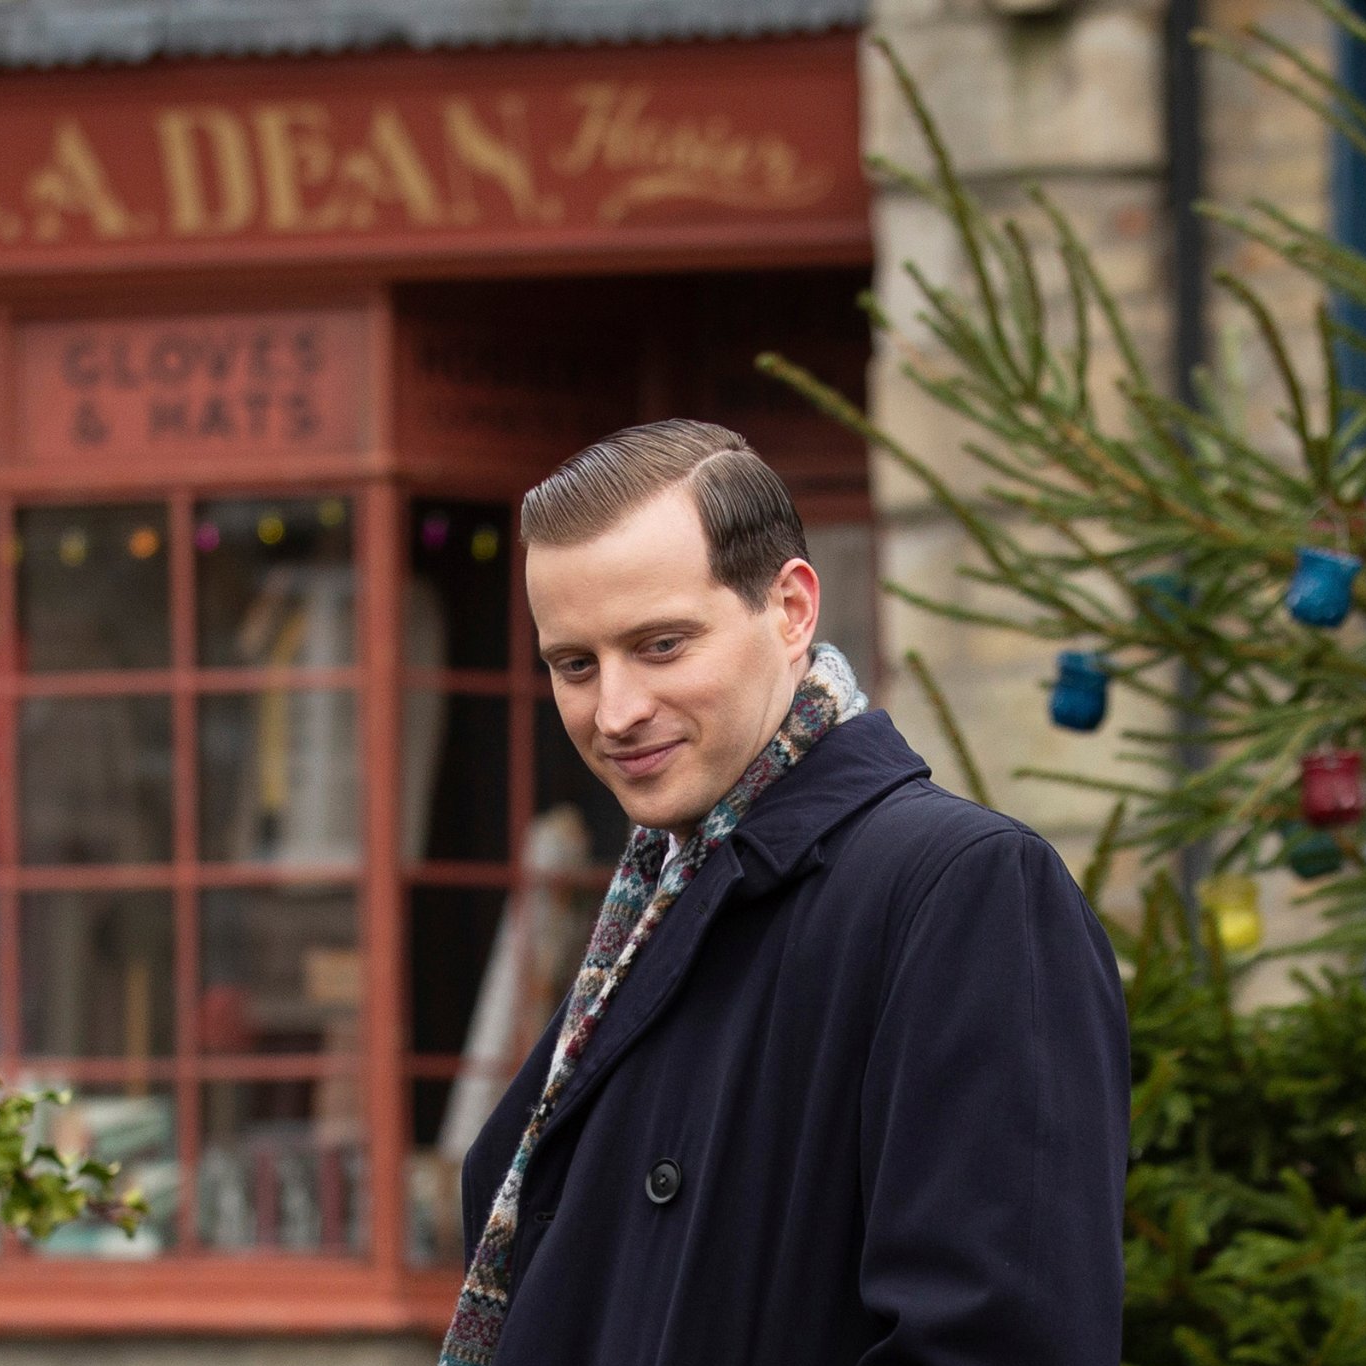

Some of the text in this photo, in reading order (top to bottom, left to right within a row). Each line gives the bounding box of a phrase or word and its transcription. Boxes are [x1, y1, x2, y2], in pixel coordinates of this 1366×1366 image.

[60, 327, 323, 391] GLOVES
[70, 393, 323, 447] & HATS
